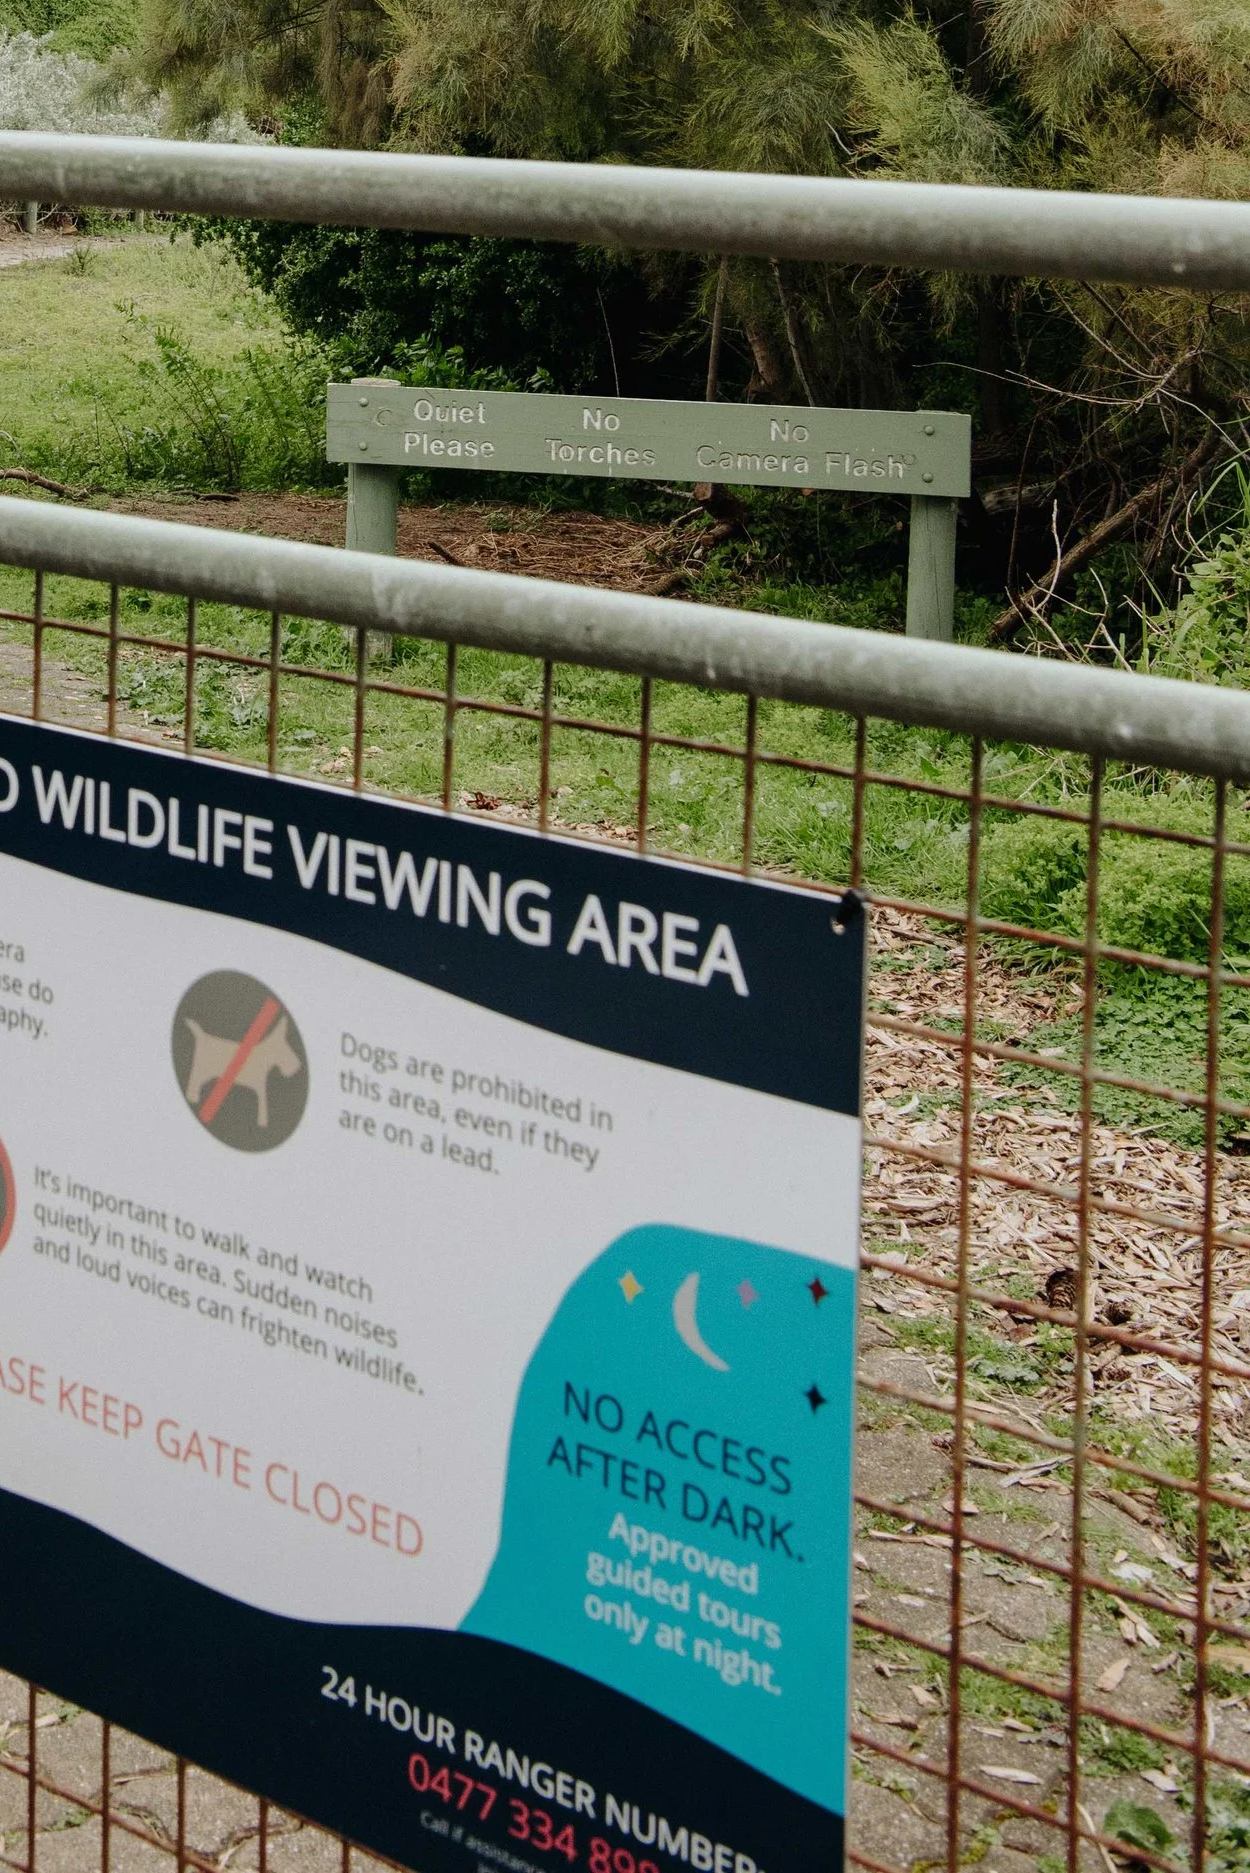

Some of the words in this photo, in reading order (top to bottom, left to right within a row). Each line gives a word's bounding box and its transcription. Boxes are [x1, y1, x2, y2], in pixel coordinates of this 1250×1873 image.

[403, 430, 496, 458] Please
[413, 398, 486, 425] Quiet
[544, 437, 656, 466] Torches
[582, 407, 621, 432] No
[696, 444, 810, 474] Camera
[824, 451, 906, 479] Flash
[770, 418, 810, 443] No
[31, 764, 276, 880] WILDLIFE
[286, 824, 552, 948] VIEWING
[565, 893, 750, 998] AREA
[28, 978, 55, 1006] do
[339, 1069, 382, 1103] this
[387, 1087, 447, 1124] area,
[454, 1107, 513, 1142] even
[520, 1121, 538, 1147] if
[544, 1129, 600, 1173] they
[340, 1031, 400, 1075] Dogs
[405, 1056, 445, 1085] are
[451, 1068, 582, 1126] prohibited
[589, 1101, 614, 1132] in
[338, 1108, 377, 1138] are
[382, 1123, 414, 1148] on
[420, 1134, 435, 1156] a
[441, 1134, 500, 1175] lead.
[33, 1165, 62, 1194] It's
[65, 1176, 168, 1234] important
[173, 1215, 197, 1242] to
[200, 1220, 251, 1261] walk
[256, 1245, 299, 1278] and
[304, 1260, 374, 1303] watch
[33, 1201, 102, 1246] quietly
[105, 1220, 126, 1250] in
[130, 1232, 169, 1266] this
[173, 1250, 227, 1288] area.
[232, 1269, 318, 1321] Sudden
[323, 1303, 400, 1350] noises
[32, 1235, 71, 1265] and
[75, 1242, 122, 1285] loud
[126, 1268, 192, 1310] voices
[196, 1293, 235, 1325] can
[239, 1306, 329, 1361] frighten
[333, 1341, 426, 1398] wildlife.
[58, 1375, 145, 1440] KEEP
[155, 1417, 252, 1491] GATE
[264, 1461, 425, 1560] CLOSED
[563, 1381, 624, 1433] NO
[636, 1410, 793, 1496] ACCESS
[547, 1435, 668, 1510] AFTER
[682, 1481, 805, 1564] DARK.
[585, 1550, 690, 1613] guided
[698, 1591, 782, 1649] tours
[608, 1511, 760, 1596] Approved
[583, 1593, 650, 1645] only
[655, 1623, 687, 1656] at
[693, 1637, 783, 1697] night.
[320, 1665, 358, 1708] 24
[364, 1684, 456, 1755] HOUR
[464, 1728, 597, 1819] RANGER
[407, 1751, 499, 1822] 0477
[507, 1798, 579, 1863] 334
